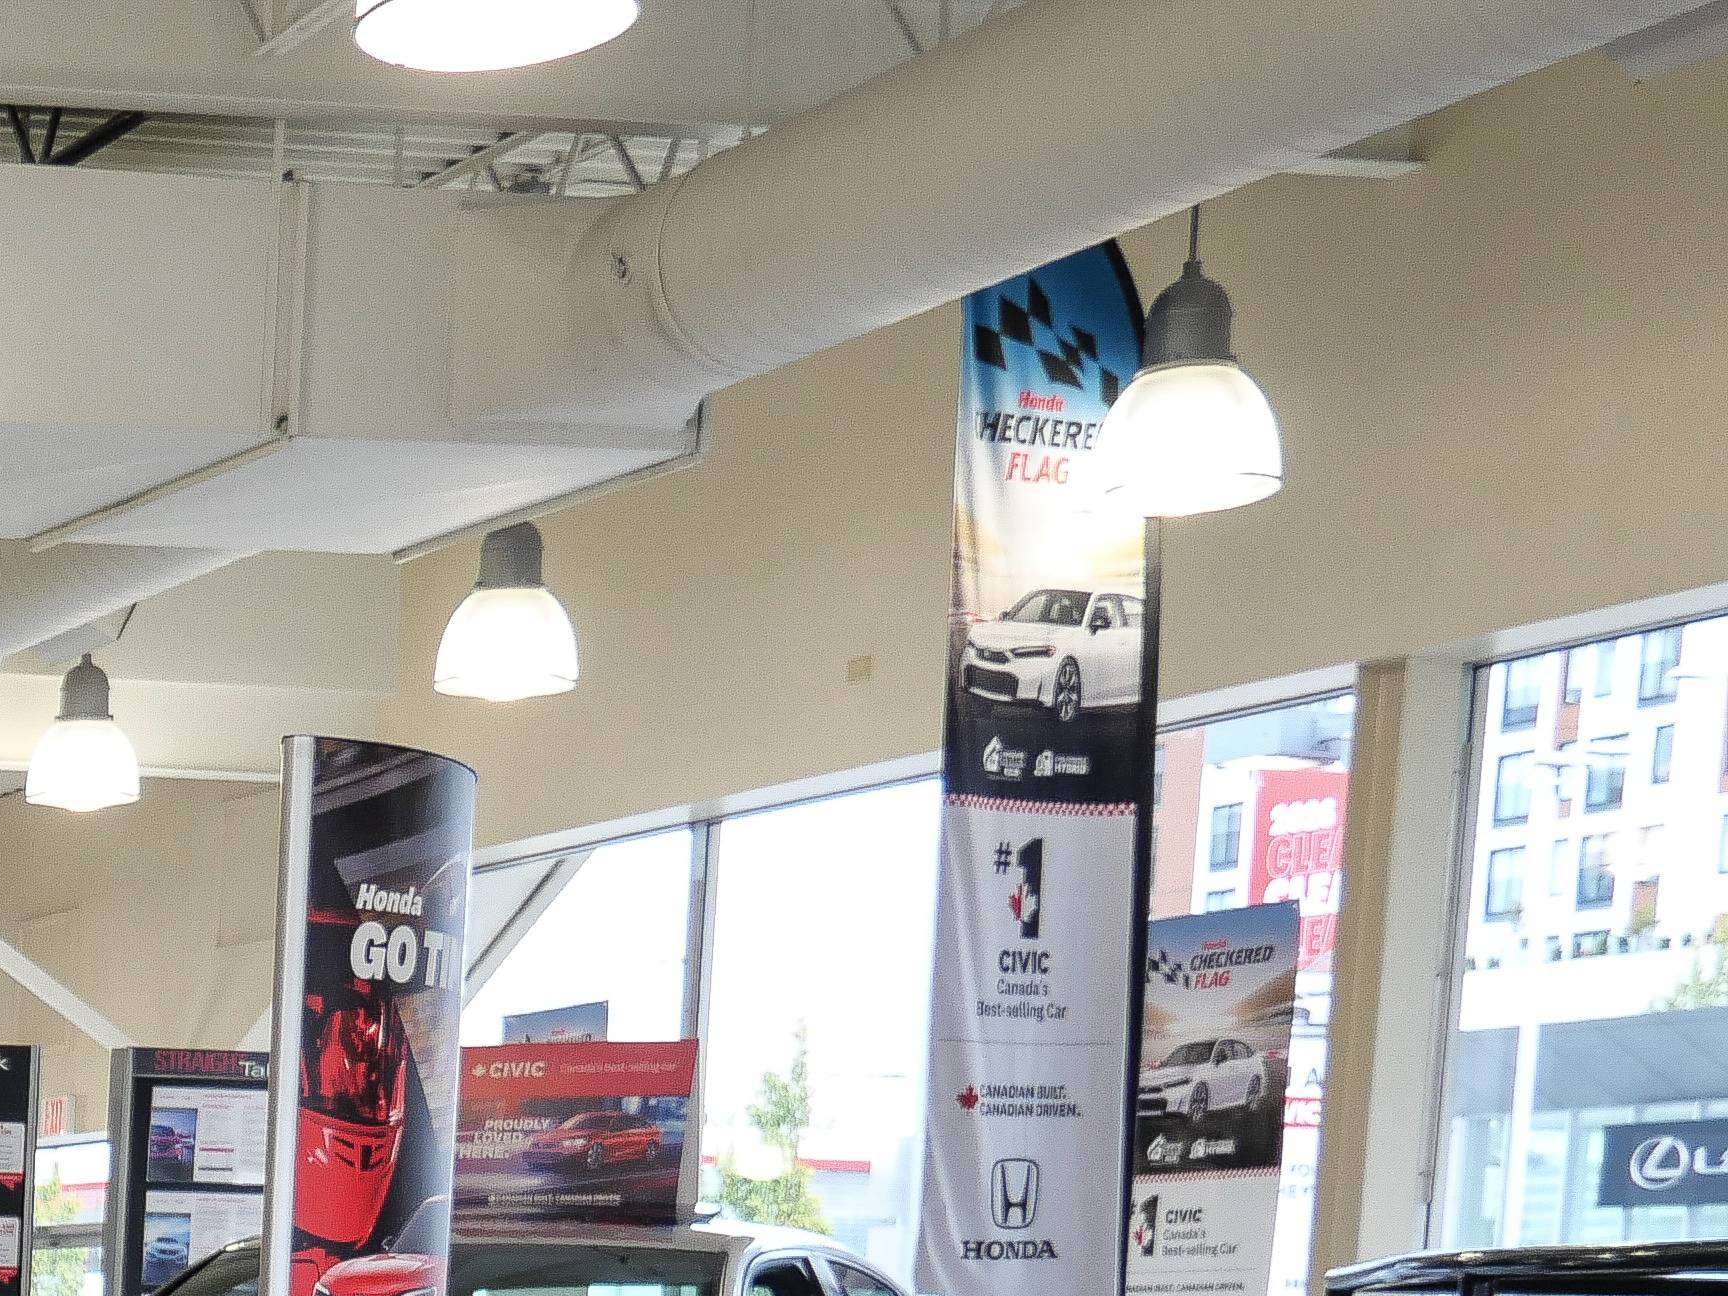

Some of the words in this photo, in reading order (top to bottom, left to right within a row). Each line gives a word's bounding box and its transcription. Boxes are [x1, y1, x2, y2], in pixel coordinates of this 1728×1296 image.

[978, 410, 1104, 450] HECKERE
[1006, 451, 1069, 484] FLAG
[995, 838, 1043, 939] #1
[355, 883, 423, 917] Honda
[350, 921, 417, 984] GO
[999, 949, 1050, 974] CIVIC
[1189, 945, 1275, 972] CHECKERED
[996, 978, 1048, 996] Canada's
[1194, 969, 1232, 991] FLAG
[1046, 1002, 1067, 1020] Car
[238, 1060, 265, 1077] Ta
[489, 1061, 547, 1078] CIVIC
[979, 1084, 1034, 1099] CANADIAN
[979, 1103, 1034, 1117] CANADIAN
[484, 1117, 551, 1131] PROUDLY
[1165, 1208, 1203, 1224] CIVIC
[961, 1239, 1058, 1261] HONDA
